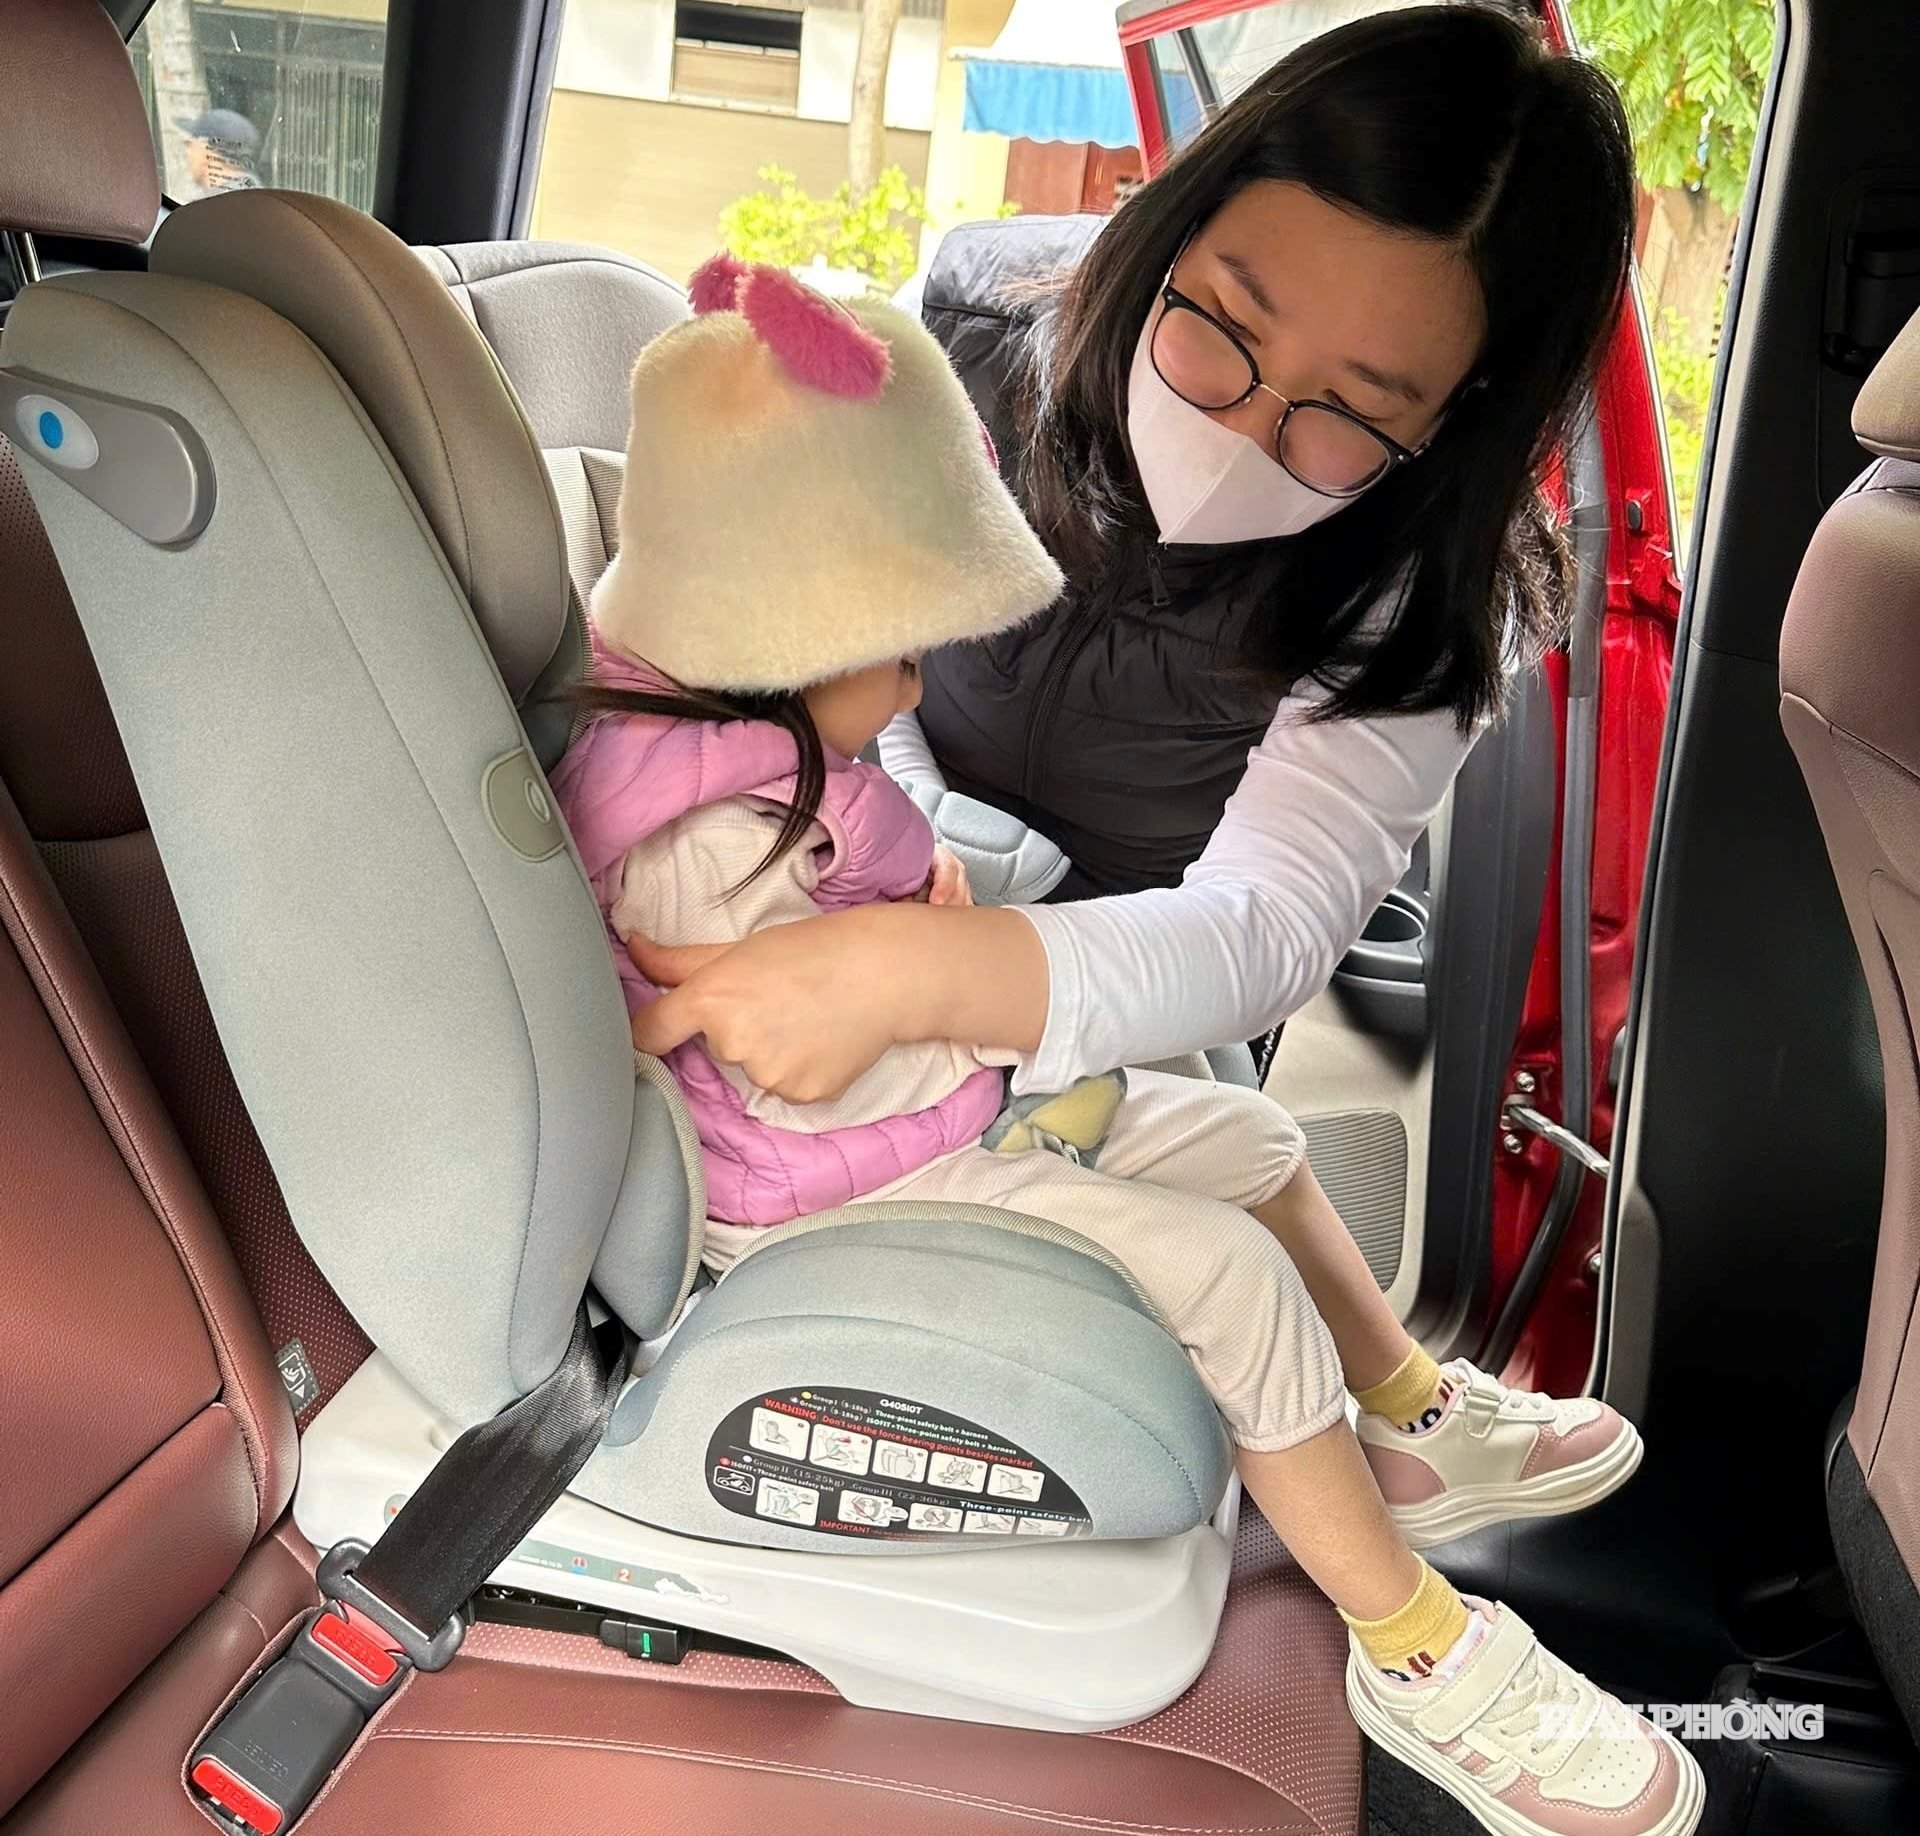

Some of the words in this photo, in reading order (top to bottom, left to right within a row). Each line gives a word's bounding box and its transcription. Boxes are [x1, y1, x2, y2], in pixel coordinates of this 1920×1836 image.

[763, 1398, 818, 1421] WARNING
[822, 1414, 846, 1428] Don't
[846, 1422, 864, 1432] use
[863, 1425, 878, 1436] the
[879, 1429, 901, 1441] force
[902, 1434, 935, 1450] bearing
[936, 1443, 965, 1455] points
[965, 1448, 999, 1462] besides
[1000, 1456, 1034, 1469] marked
[917, 1419, 939, 1431] safety
[939, 1423, 955, 1434] belt
[960, 1428, 989, 1441] harness
[940, 1433, 964, 1446] safety
[964, 1438, 981, 1449] belt
[987, 1443, 1018, 1456] harness
[798, 1479, 820, 1490] safety
[820, 1483, 834, 1493] belt
[959, 1500, 1028, 1517] Three-point
[1030, 1510, 1066, 1521] safety
[819, 1519, 871, 1534] IMPORTANT
